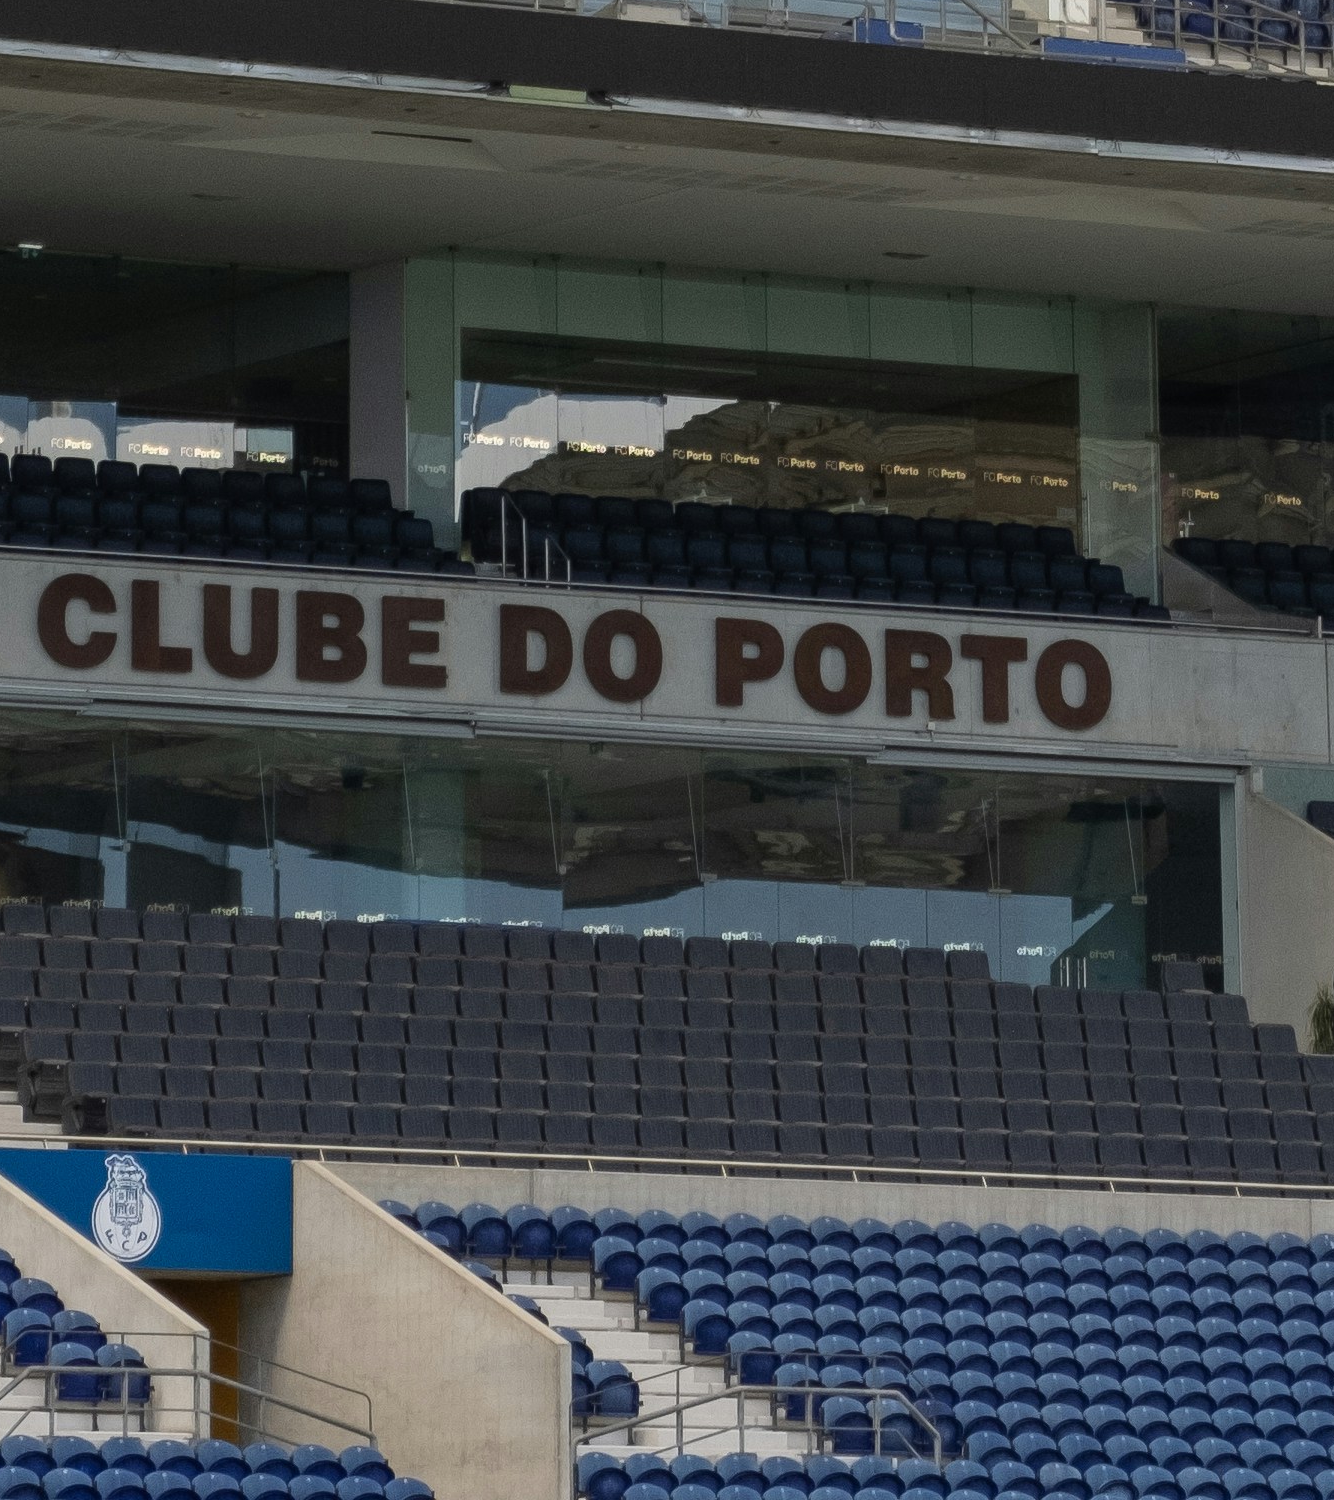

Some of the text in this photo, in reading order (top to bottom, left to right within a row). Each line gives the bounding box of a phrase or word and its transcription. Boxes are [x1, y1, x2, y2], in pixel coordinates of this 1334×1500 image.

[65, 439, 91, 450] Porto
[524, 438, 549, 449] Porto
[194, 448, 221, 459] Porto
[260, 453, 285, 464] Porto
[687, 450, 712, 461] Porto
[734, 454, 759, 465] Porto
[791, 458, 816, 469] Porto
[839, 461, 864, 472] Porto
[894, 465, 918, 476] Porto
[941, 469, 966, 480] Porto
[1043, 477, 1068, 487] Porto
[1195, 489, 1219, 500] Porto
[1277, 495, 1301, 505] Porto
[37, 573, 448, 688] CLUBE
[500, 603, 663, 702] DO
[715, 617, 1112, 730] PORTO
